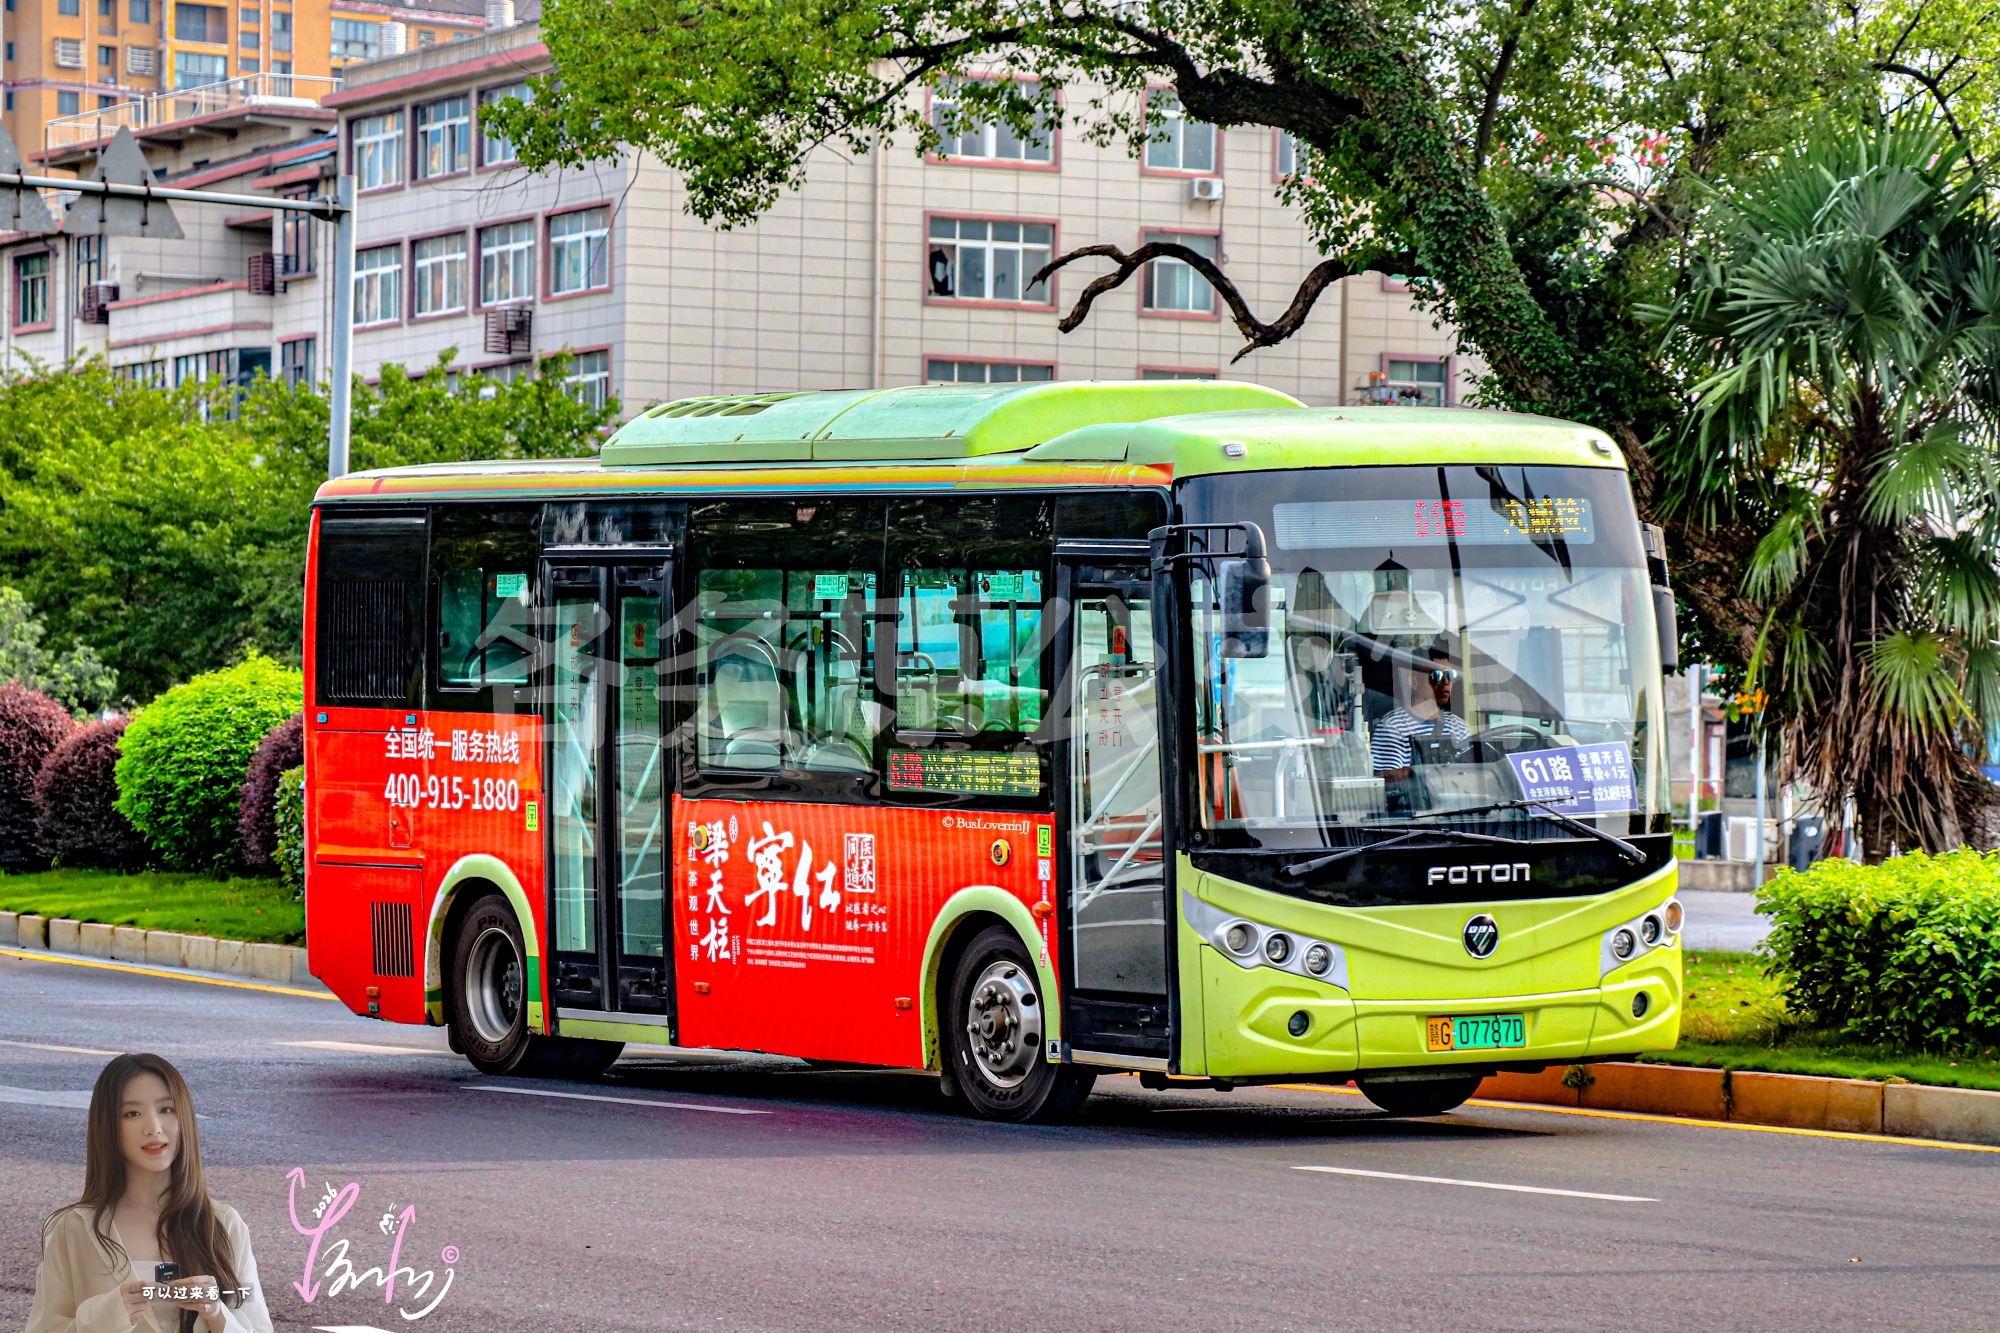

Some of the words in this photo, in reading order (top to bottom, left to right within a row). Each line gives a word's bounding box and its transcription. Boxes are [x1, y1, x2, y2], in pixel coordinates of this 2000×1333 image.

[816, 576, 837, 586] 应急出口
[384, 725, 519, 764] 全国统一服务热线
[1521, 755, 1573, 783] 61路
[1577, 750, 1625, 766] 空调开启
[1582, 766, 1628, 782] 票价+1元
[384, 773, 519, 811] 400-915-1880
[1427, 863, 1531, 886] FOTON
[700, 820, 732, 963] 梁天柱
[846, 902, 887, 916] 以医者之心
